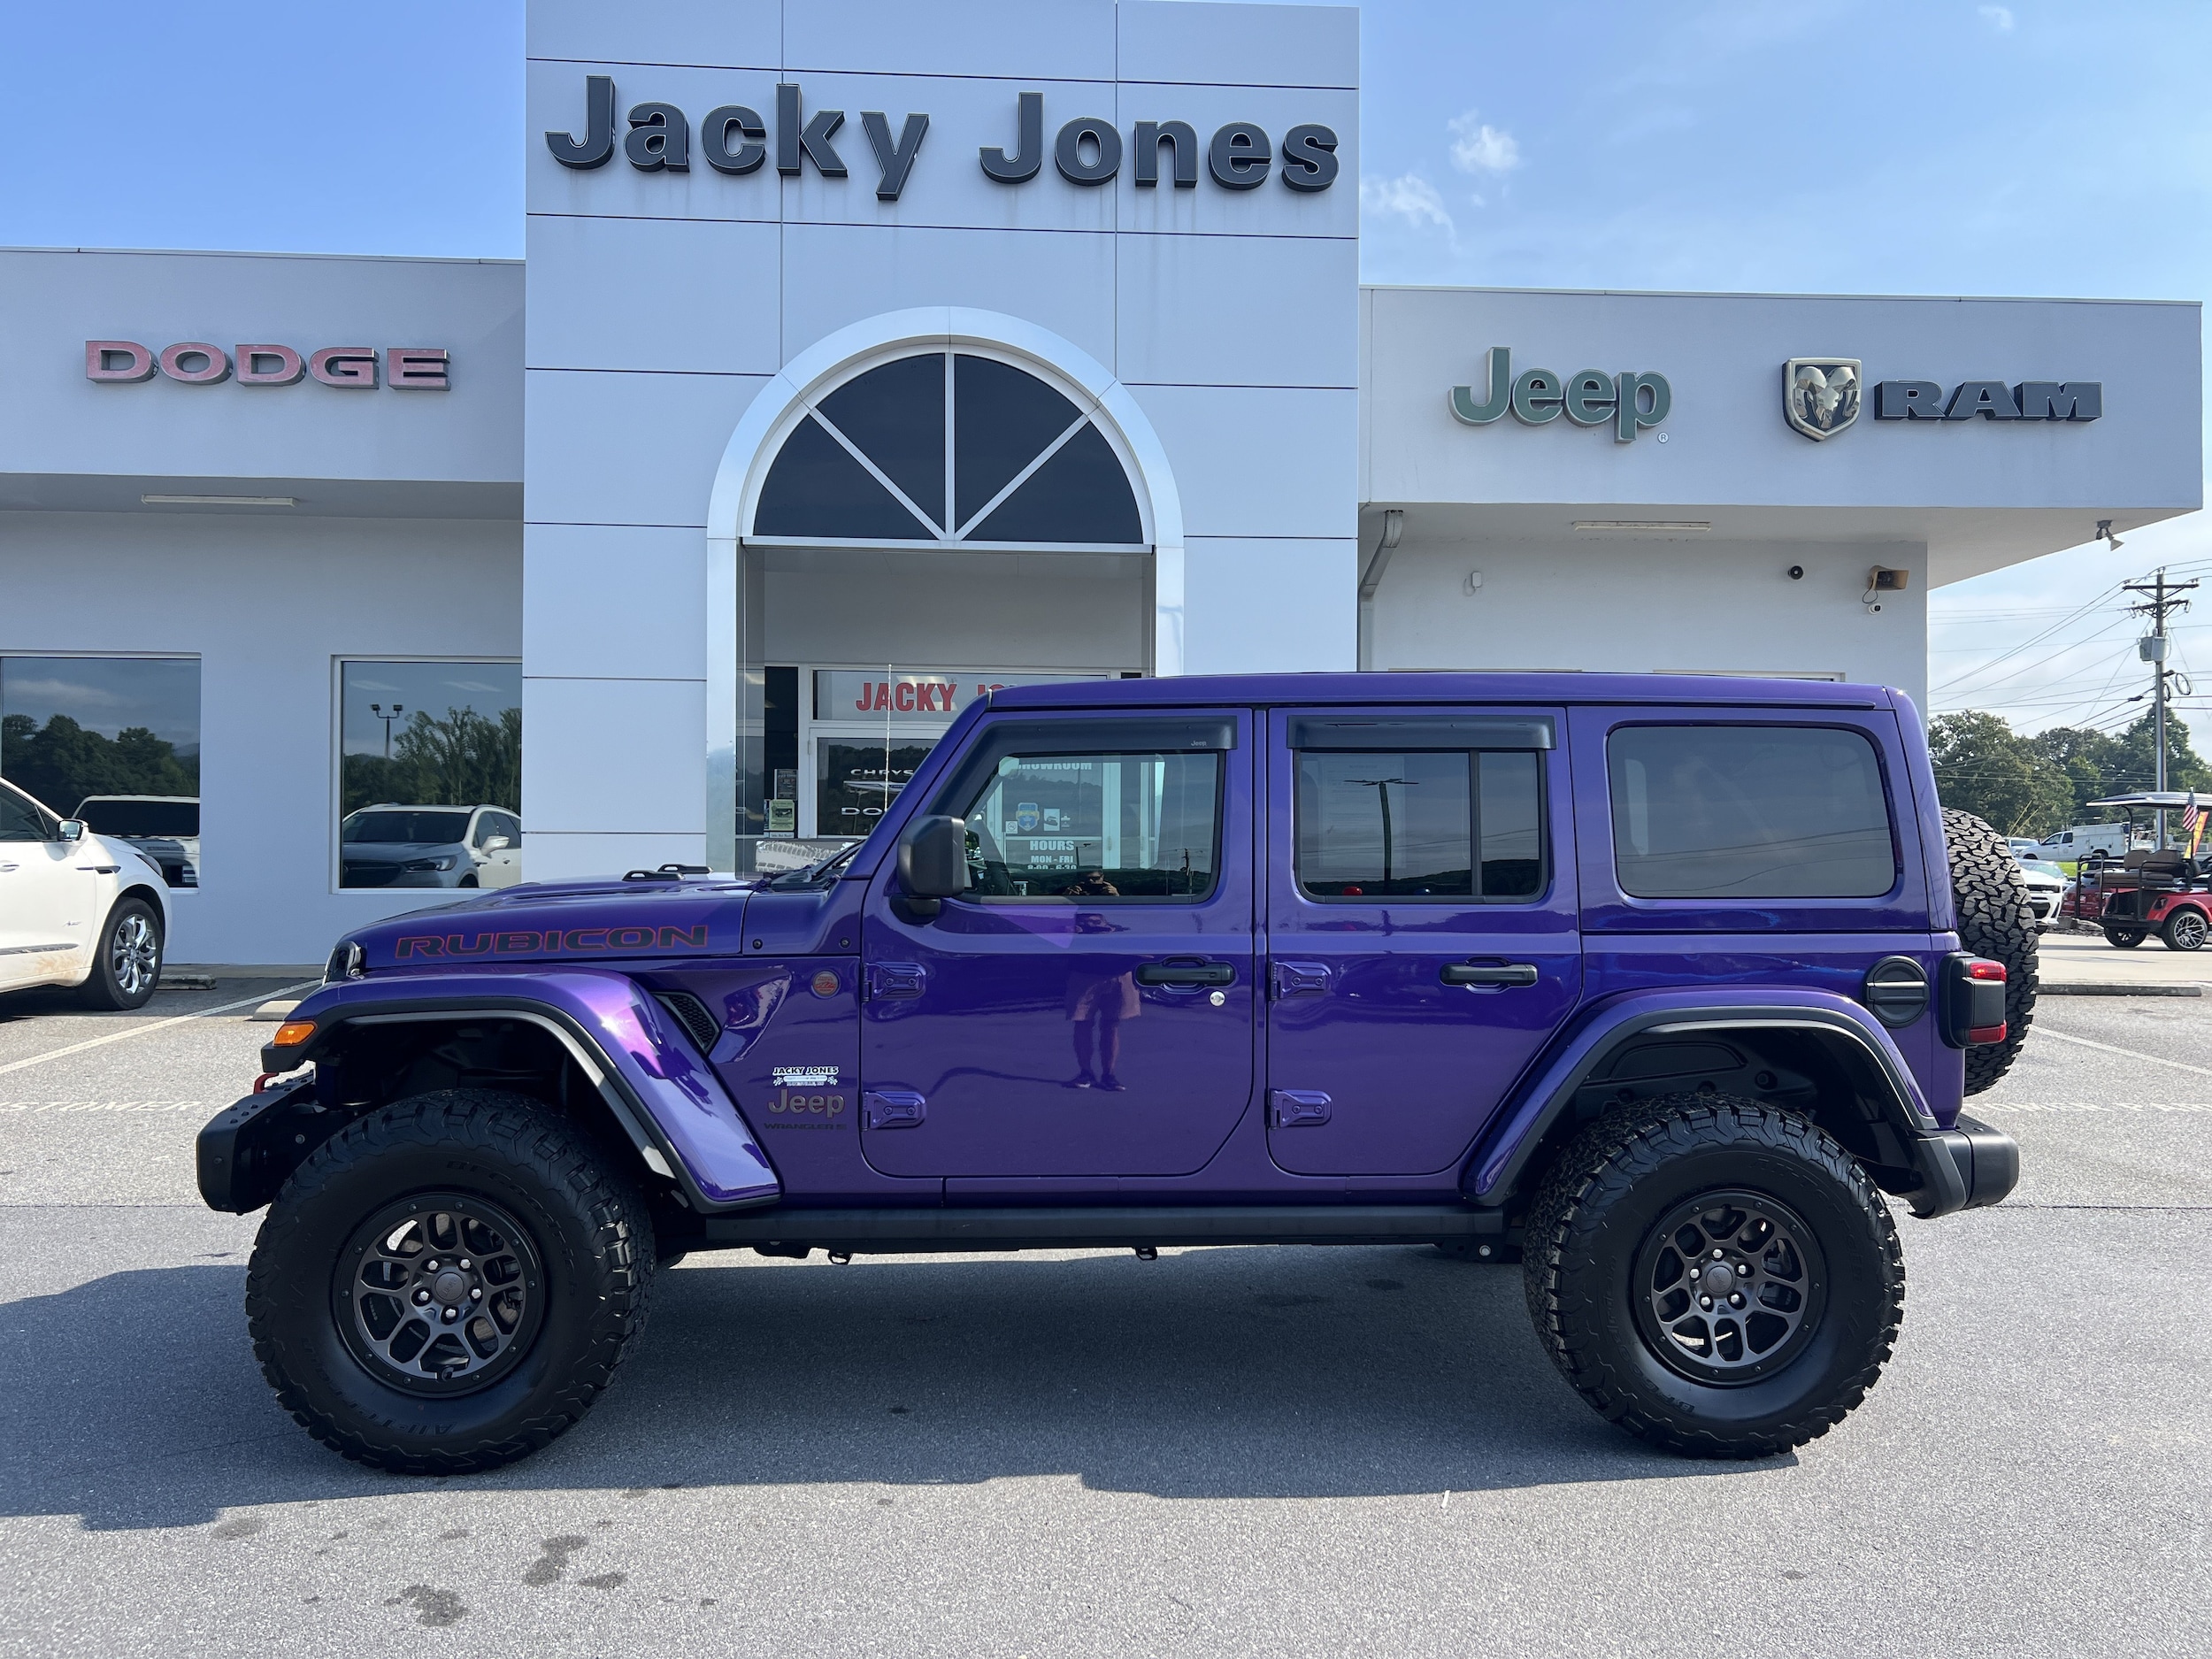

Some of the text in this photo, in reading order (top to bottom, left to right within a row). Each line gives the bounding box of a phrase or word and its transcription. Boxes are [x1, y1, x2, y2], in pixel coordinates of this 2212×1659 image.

[544, 74, 1340, 201] Jacky Jones
[85, 340, 451, 391] DODGE
[1448, 346, 1673, 443] Jeep
[1873, 380, 2103, 422] RAM
[855, 681, 958, 712] JACKY
[1029, 840, 1075, 851] HOURS
[1030, 855, 1052, 864] MON
[1058, 855, 1074, 864] FRI
[395, 925, 709, 958] RUBICON
[772, 1066, 839, 1075] JACKY JONES
[768, 1088, 845, 1118] Jeep
